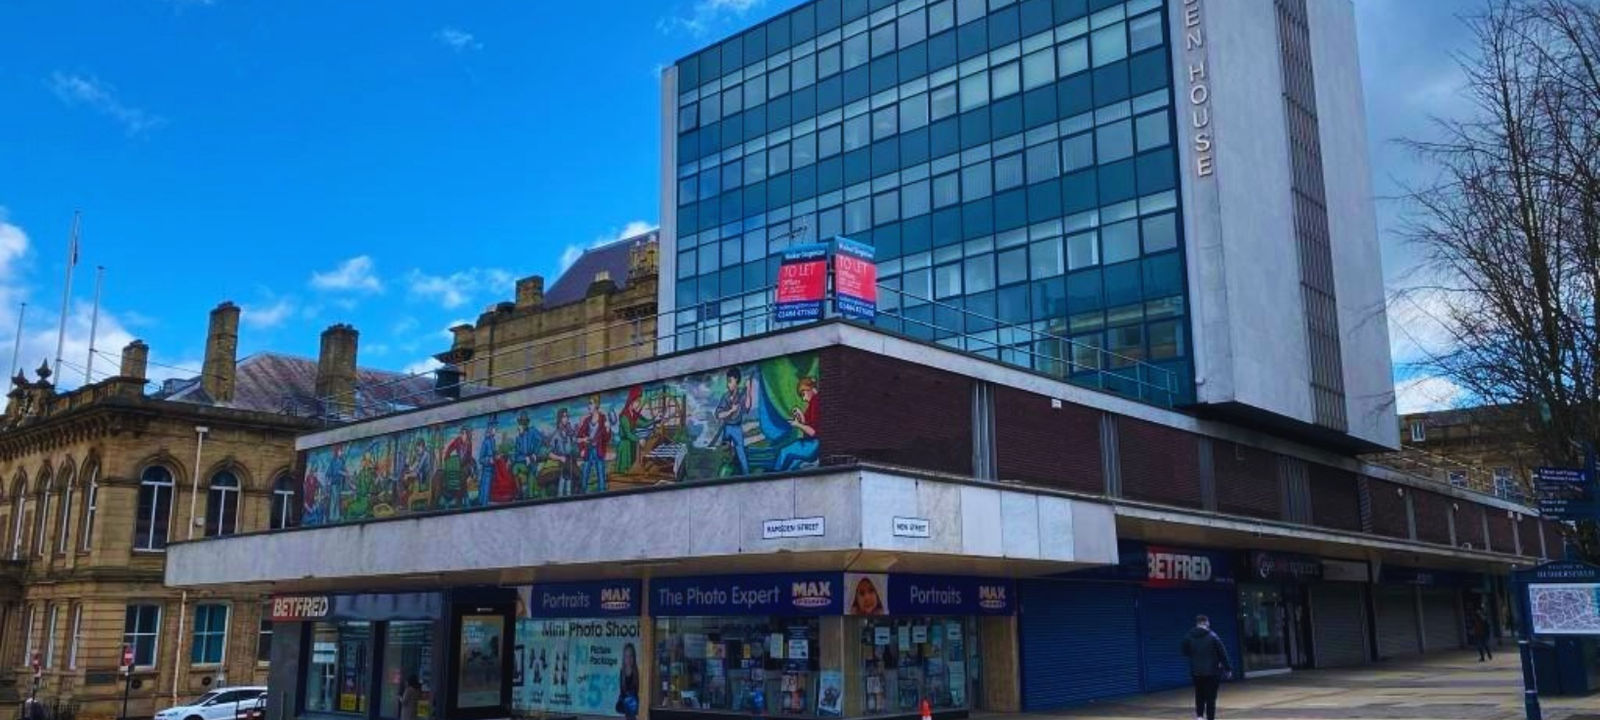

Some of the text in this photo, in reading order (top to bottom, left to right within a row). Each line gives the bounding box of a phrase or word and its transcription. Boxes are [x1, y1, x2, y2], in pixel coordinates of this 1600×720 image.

[1188, 62, 1213, 177] HOUSE
[783, 262, 815, 277] TO LET
[839, 255, 851, 271] TO
[852, 258, 867, 276] LET
[766, 523, 819, 533] RAMSDEN STREET
[910, 524, 926, 532] STREET
[1147, 553, 1212, 581] BETFRED
[601, 587, 631, 602] MAX
[658, 588, 683, 606] The
[687, 586, 727, 605] Photo
[732, 585, 780, 608] Expert
[791, 581, 832, 597] MAX
[910, 585, 962, 605] Portraits
[979, 586, 1006, 600] MAX
[272, 596, 329, 617] BETFRED
[543, 591, 591, 609] Portraits
[542, 622, 565, 637] Mini
[569, 621, 602, 637] Photo
